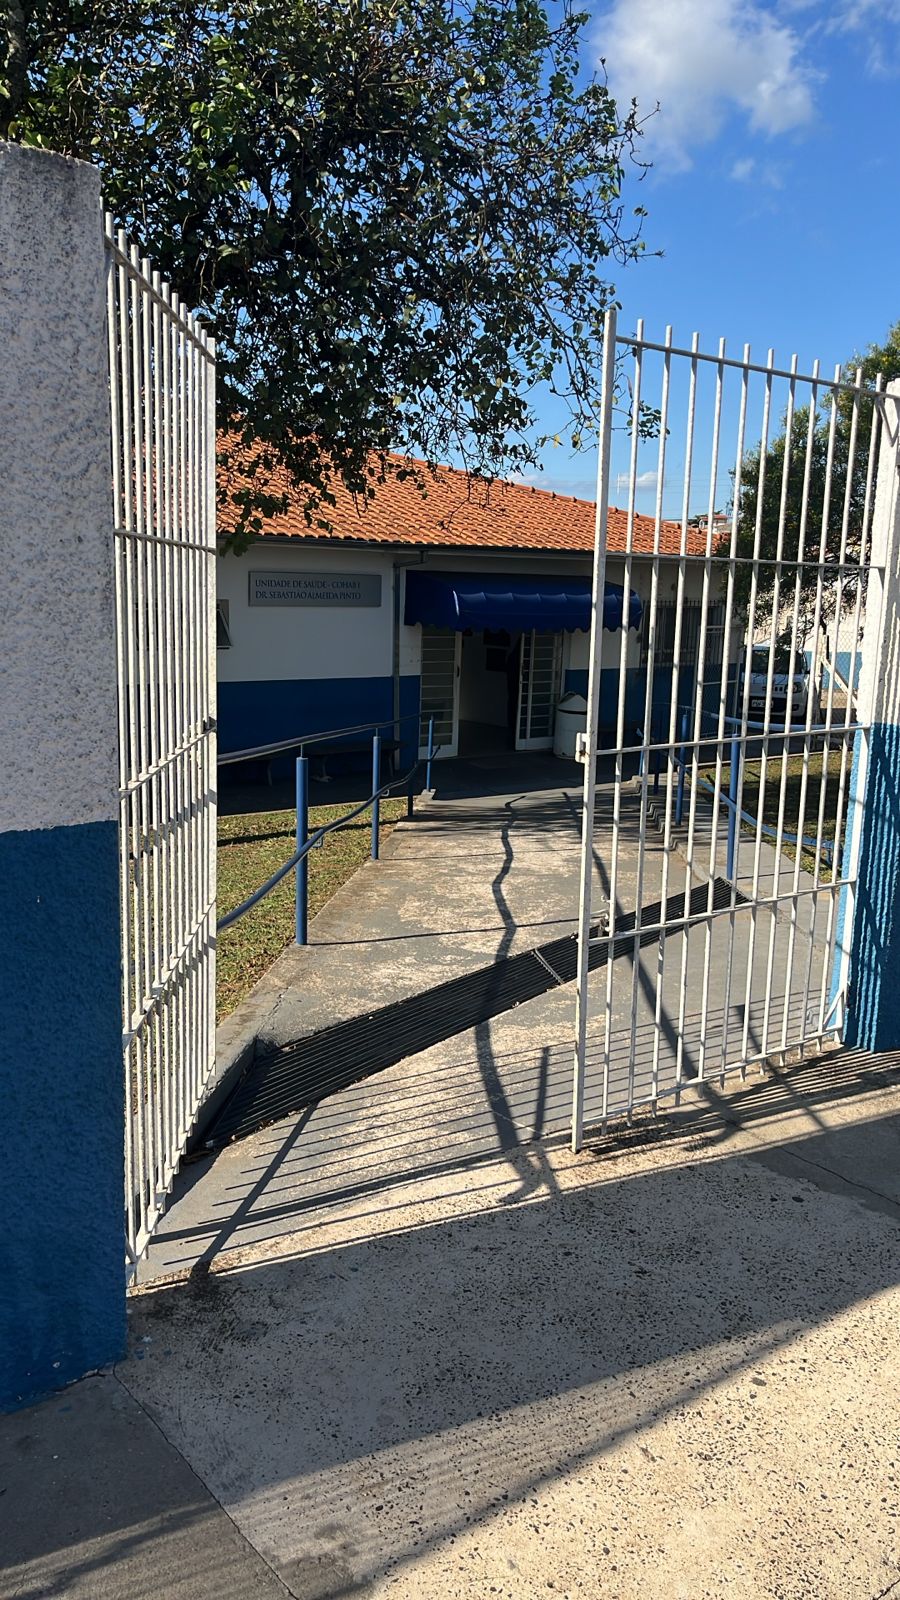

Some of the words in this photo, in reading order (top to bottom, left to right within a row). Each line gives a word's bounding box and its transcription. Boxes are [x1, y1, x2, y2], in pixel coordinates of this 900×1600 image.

[256, 579, 290, 588] UNIDADE
[292, 580, 302, 588] DE
[307, 591, 339, 600] ALMEIDA
[339, 591, 361, 600] PINTO
